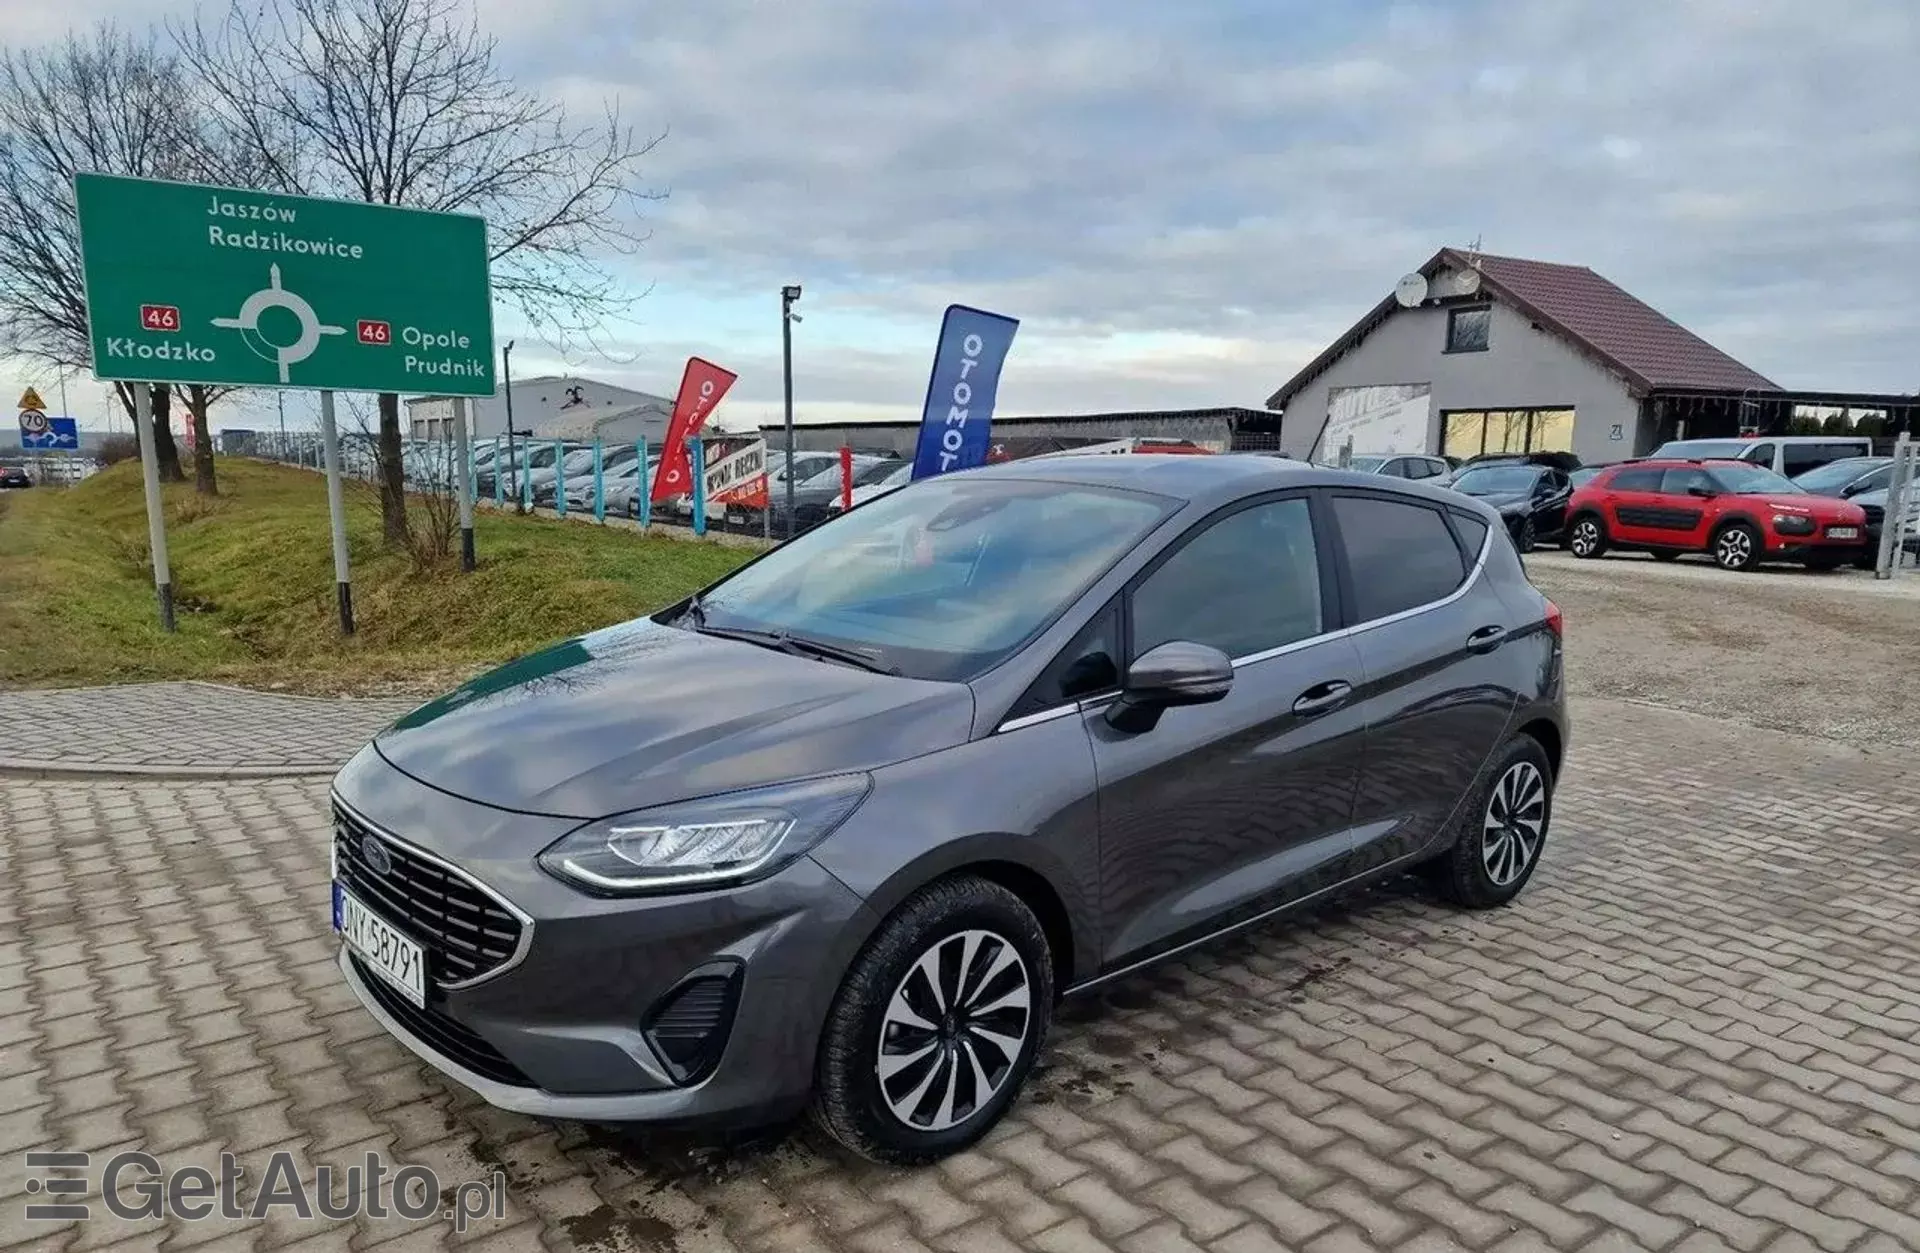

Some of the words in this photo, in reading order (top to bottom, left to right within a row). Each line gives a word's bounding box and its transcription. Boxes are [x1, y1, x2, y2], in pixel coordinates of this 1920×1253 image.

[207, 195, 296, 223] Jaszów
[208, 225, 364, 259] Radzikowice
[147, 310, 174, 327] 46
[363, 325, 386, 341] 46
[402, 326, 470, 351] Opole
[106, 337, 216, 362] Kłodzko
[405, 355, 485, 377] Prudnik
[23, 414, 44, 428] 70
[371, 918, 420, 991] 58791
